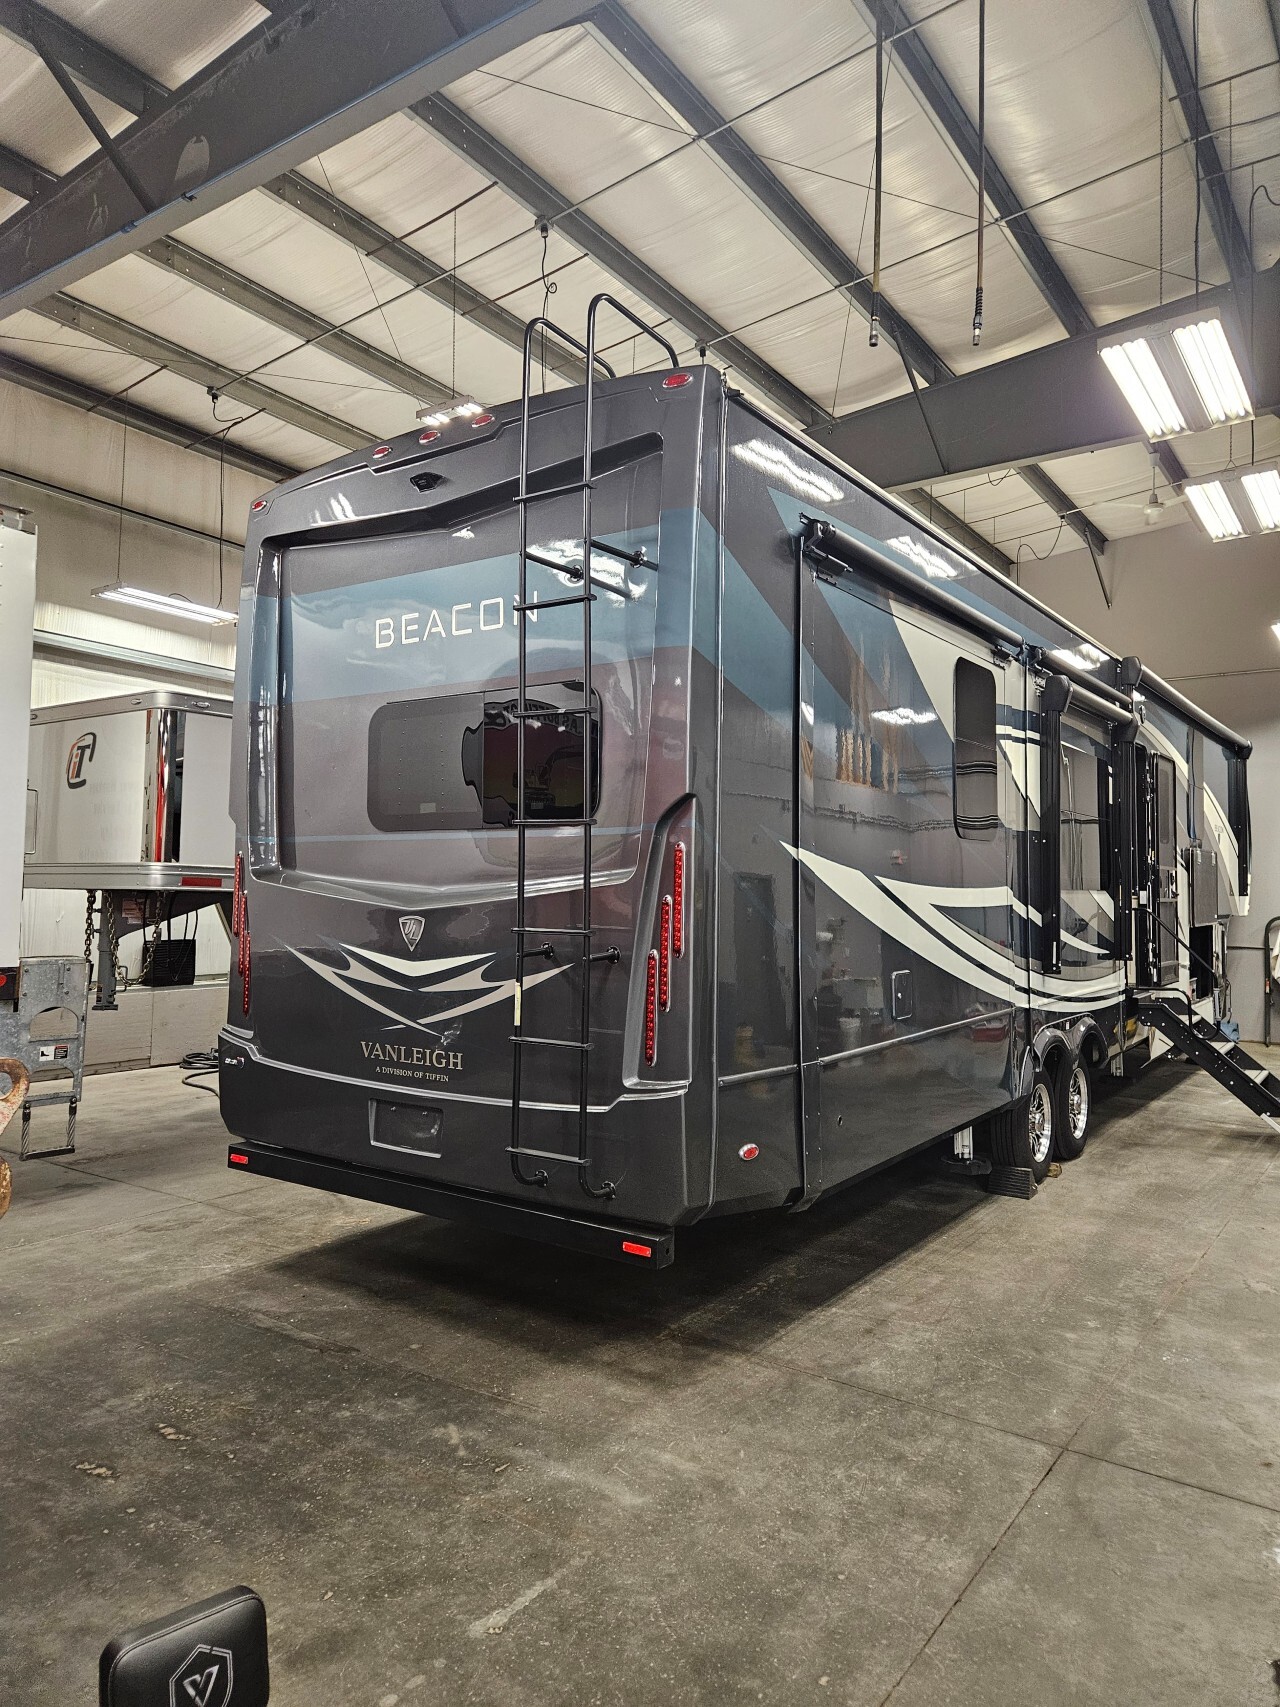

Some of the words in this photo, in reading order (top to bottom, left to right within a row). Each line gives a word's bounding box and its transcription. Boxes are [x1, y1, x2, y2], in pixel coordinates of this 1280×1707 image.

[375, 590, 538, 648] BEACON
[360, 1041, 463, 1070] VANLEIGH
[382, 1066, 413, 1078] DIVISION
[414, 1071, 424, 1079] OF
[425, 1072, 449, 1082] TIFFIN
